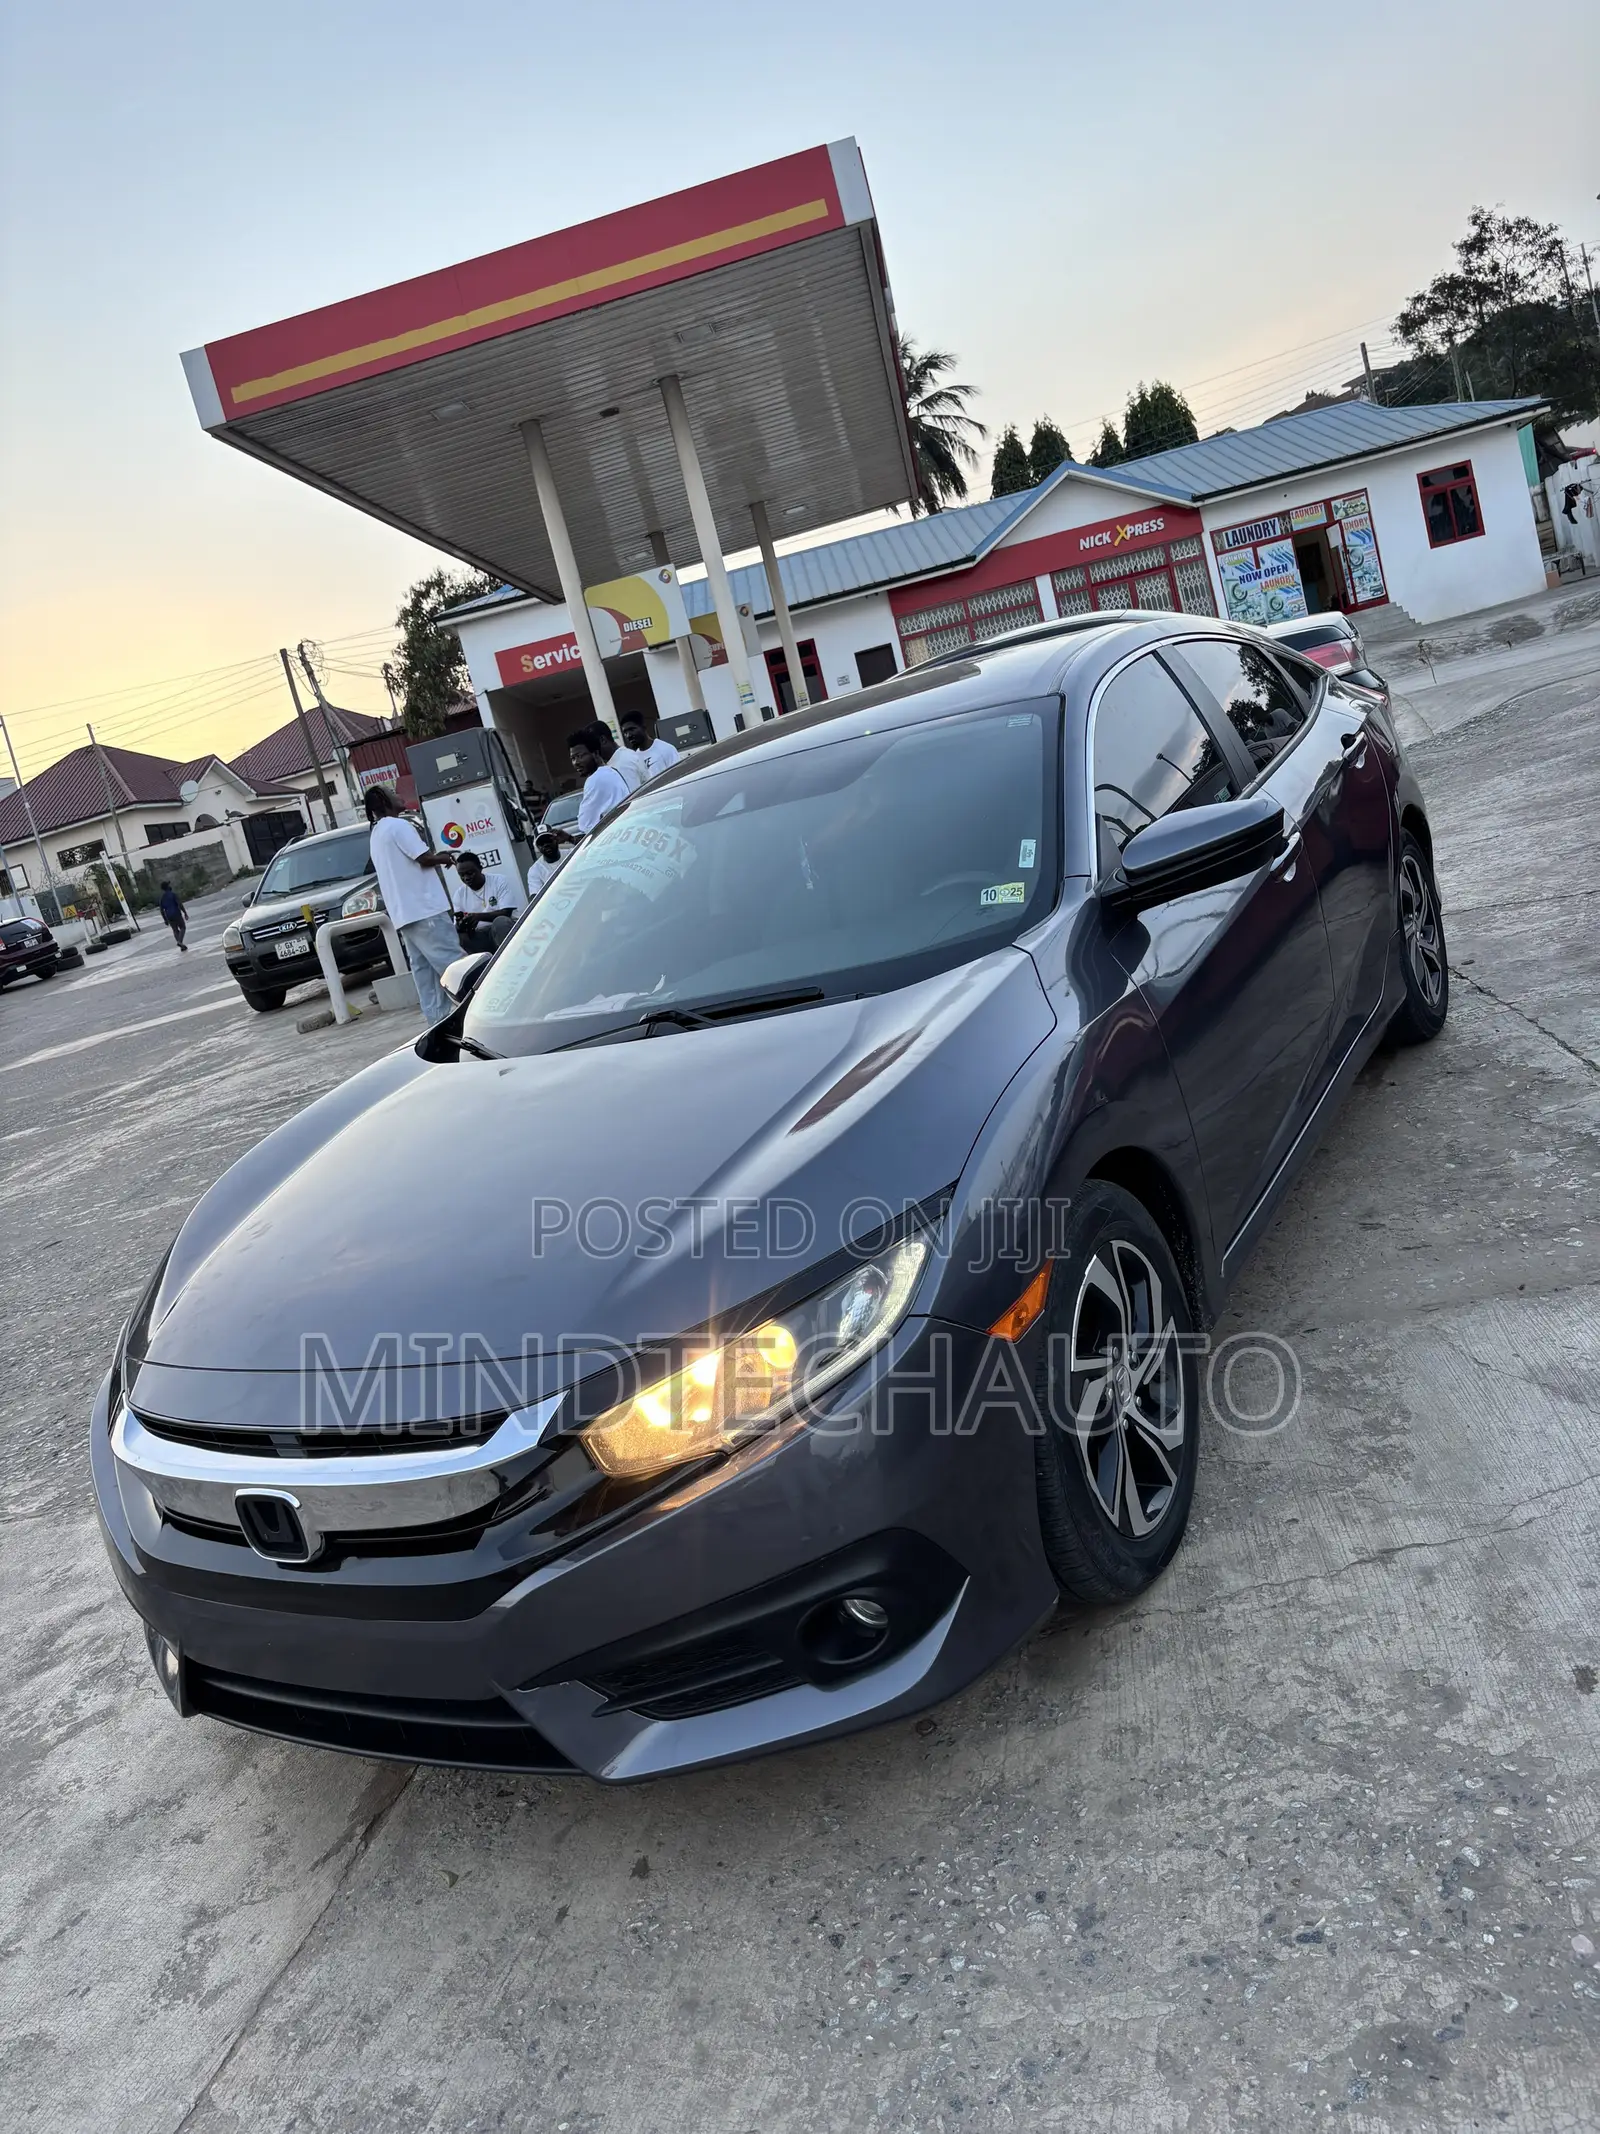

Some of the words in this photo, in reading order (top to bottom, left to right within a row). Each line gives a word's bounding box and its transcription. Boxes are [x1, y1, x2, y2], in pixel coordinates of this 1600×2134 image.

[1290, 503, 1324, 520] LAUNDRY
[1344, 517, 1368, 530] UNDRY
[1079, 531, 1112, 550] NICK
[1114, 517, 1165, 547] XPRESS
[1225, 519, 1277, 548] LAUNDRY
[1239, 569, 1263, 585] NOW
[1264, 563, 1289, 578] OPEN
[1260, 574, 1295, 591] LAUNDRY
[623, 617, 652, 632] DIESEL
[521, 643, 582, 673] Servic
[361, 767, 398, 787] LAUNDRY
[466, 817, 494, 834] NICK
[478, 850, 501, 868] SEL
[983, 889, 997, 902] 10
[1010, 887, 1023, 897] 25
